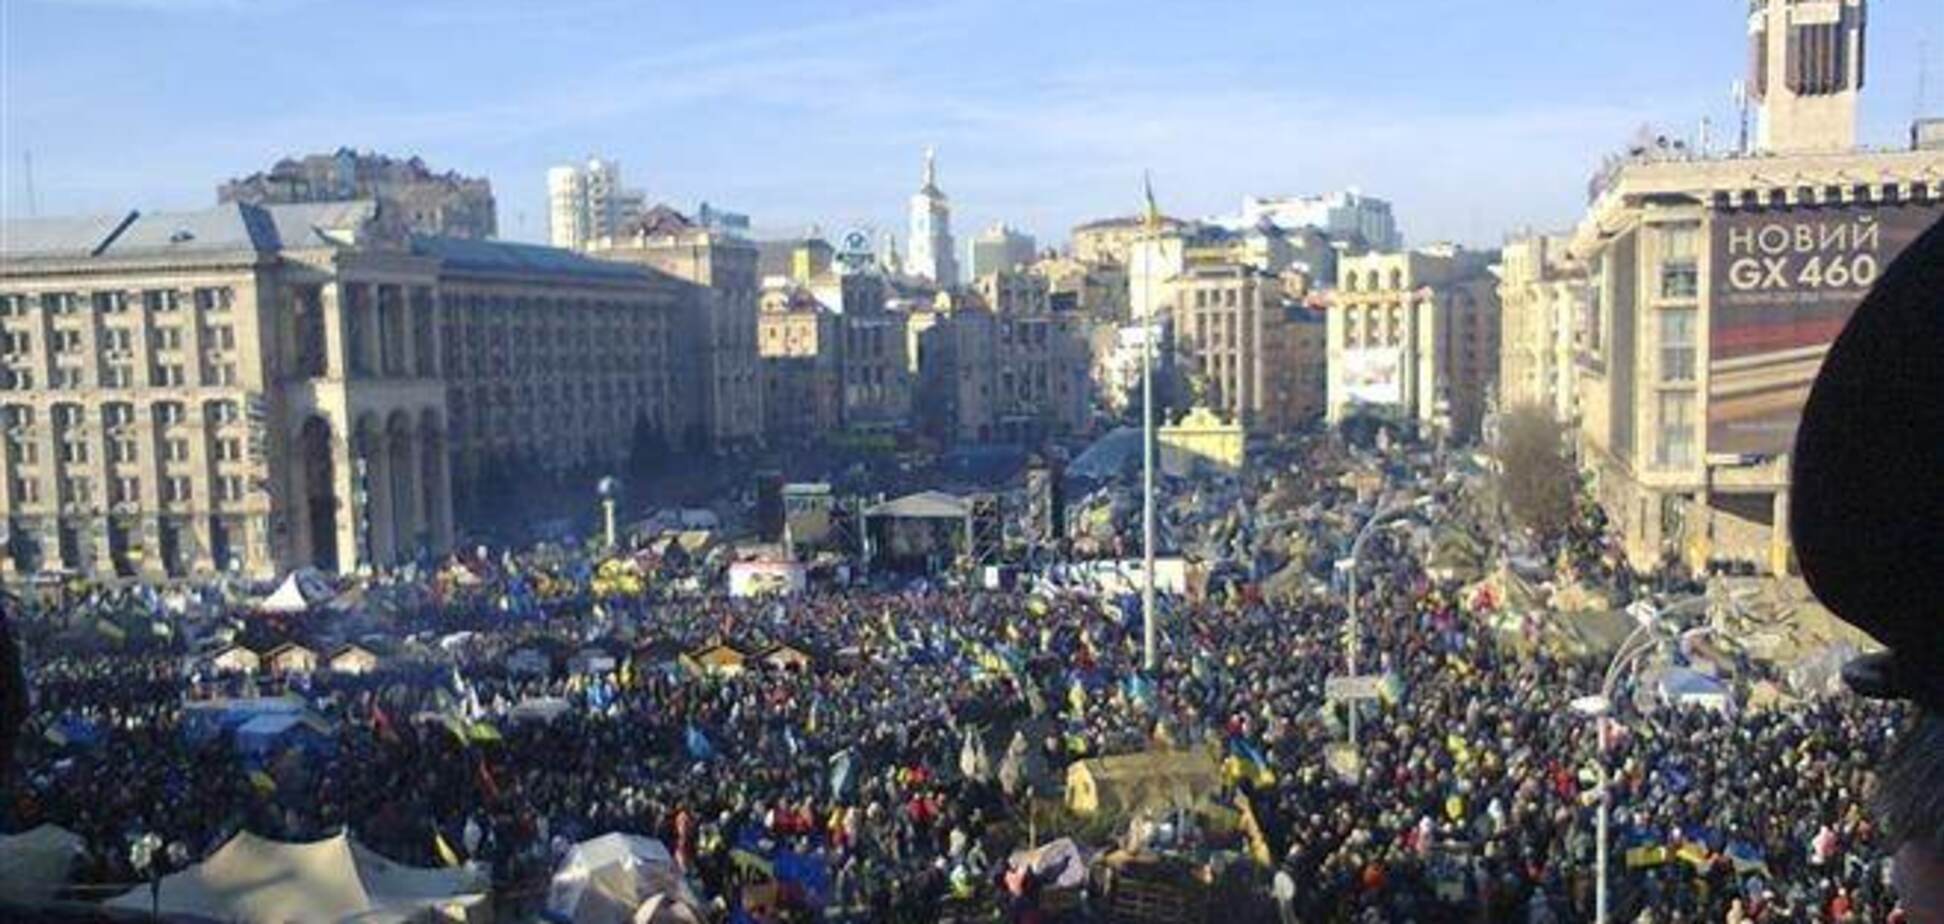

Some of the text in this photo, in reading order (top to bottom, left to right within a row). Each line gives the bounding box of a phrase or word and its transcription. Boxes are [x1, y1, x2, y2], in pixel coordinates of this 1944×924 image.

[1729, 216, 1878, 253] НОВИЙ
[1730, 254, 1877, 290] GX 460
